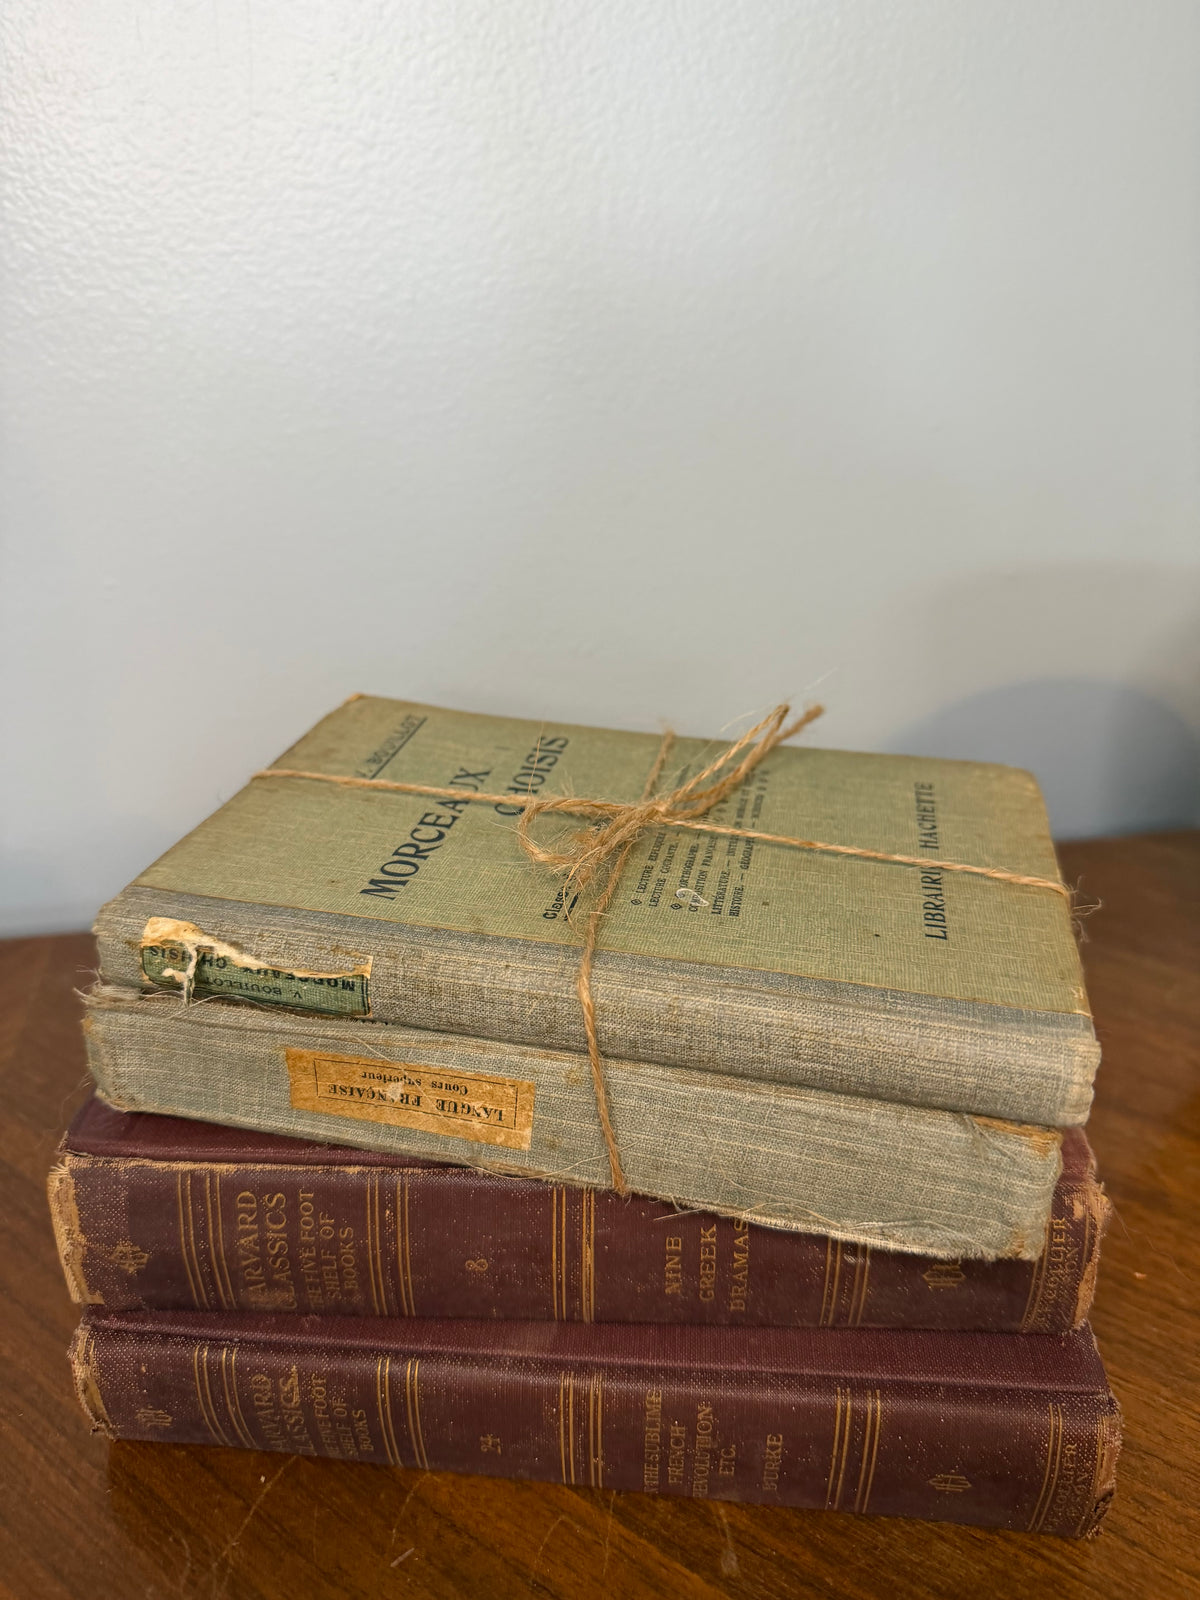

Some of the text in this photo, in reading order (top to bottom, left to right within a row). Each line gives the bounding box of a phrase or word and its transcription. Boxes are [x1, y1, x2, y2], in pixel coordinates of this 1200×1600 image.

[359, 766, 493, 901] MORCEAUX
[914, 781, 940, 850] HACHETTE
[636, 864, 654, 894] LECTURE
[649, 878, 667, 908] LECTURE
[203, 976, 282, 996] BOUILLOT
[327, 1082, 422, 1107] FRNÇAISE
[430, 1080, 469, 1096] Cours
[299, 1188, 315, 1241] FOOT
[300, 1246, 319, 1283] FIVE
[319, 1211, 342, 1300] SHELF OF
[339, 1226, 359, 1290] BOOKS
[465, 1259, 488, 1272] 8
[699, 1223, 718, 1302] GREEK
[729, 1218, 750, 1312] DRAMAS
[311, 1373, 330, 1419] FOOT
[331, 1396, 348, 1418] OF
[352, 1408, 375, 1452] BOOKS
[644, 1388, 663, 1462] SUBLIME
[667, 1423, 687, 1486] FRENCH
[718, 1443, 738, 1478] ETC.
[762, 1432, 784, 1492] BURKE
